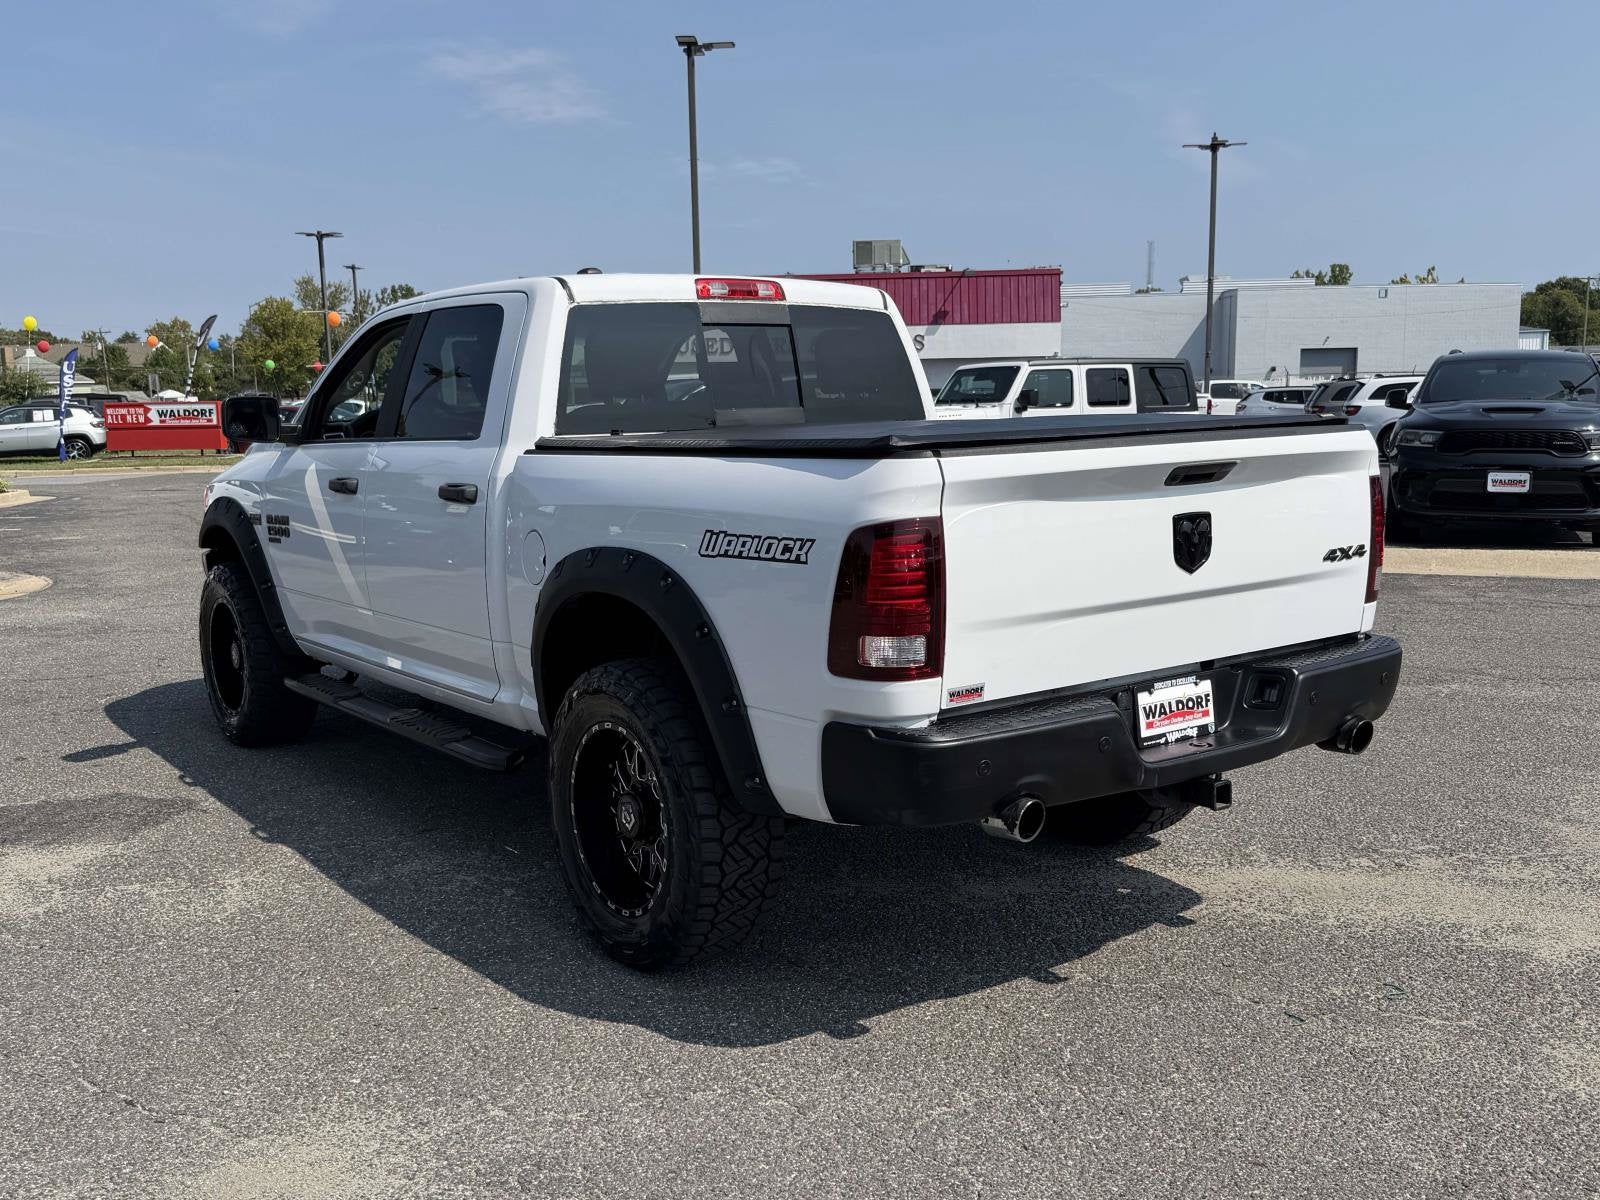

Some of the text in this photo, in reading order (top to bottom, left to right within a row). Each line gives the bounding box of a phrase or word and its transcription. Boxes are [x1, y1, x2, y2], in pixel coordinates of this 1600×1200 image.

[107, 414, 145, 424] ALL NEW
[156, 408, 214, 418] WALDORF
[698, 529, 817, 565] WARLOCK
[948, 686, 985, 699] WALDORF
[1142, 693, 1211, 720] WALDORF
[1166, 727, 1198, 742] WALDORF
